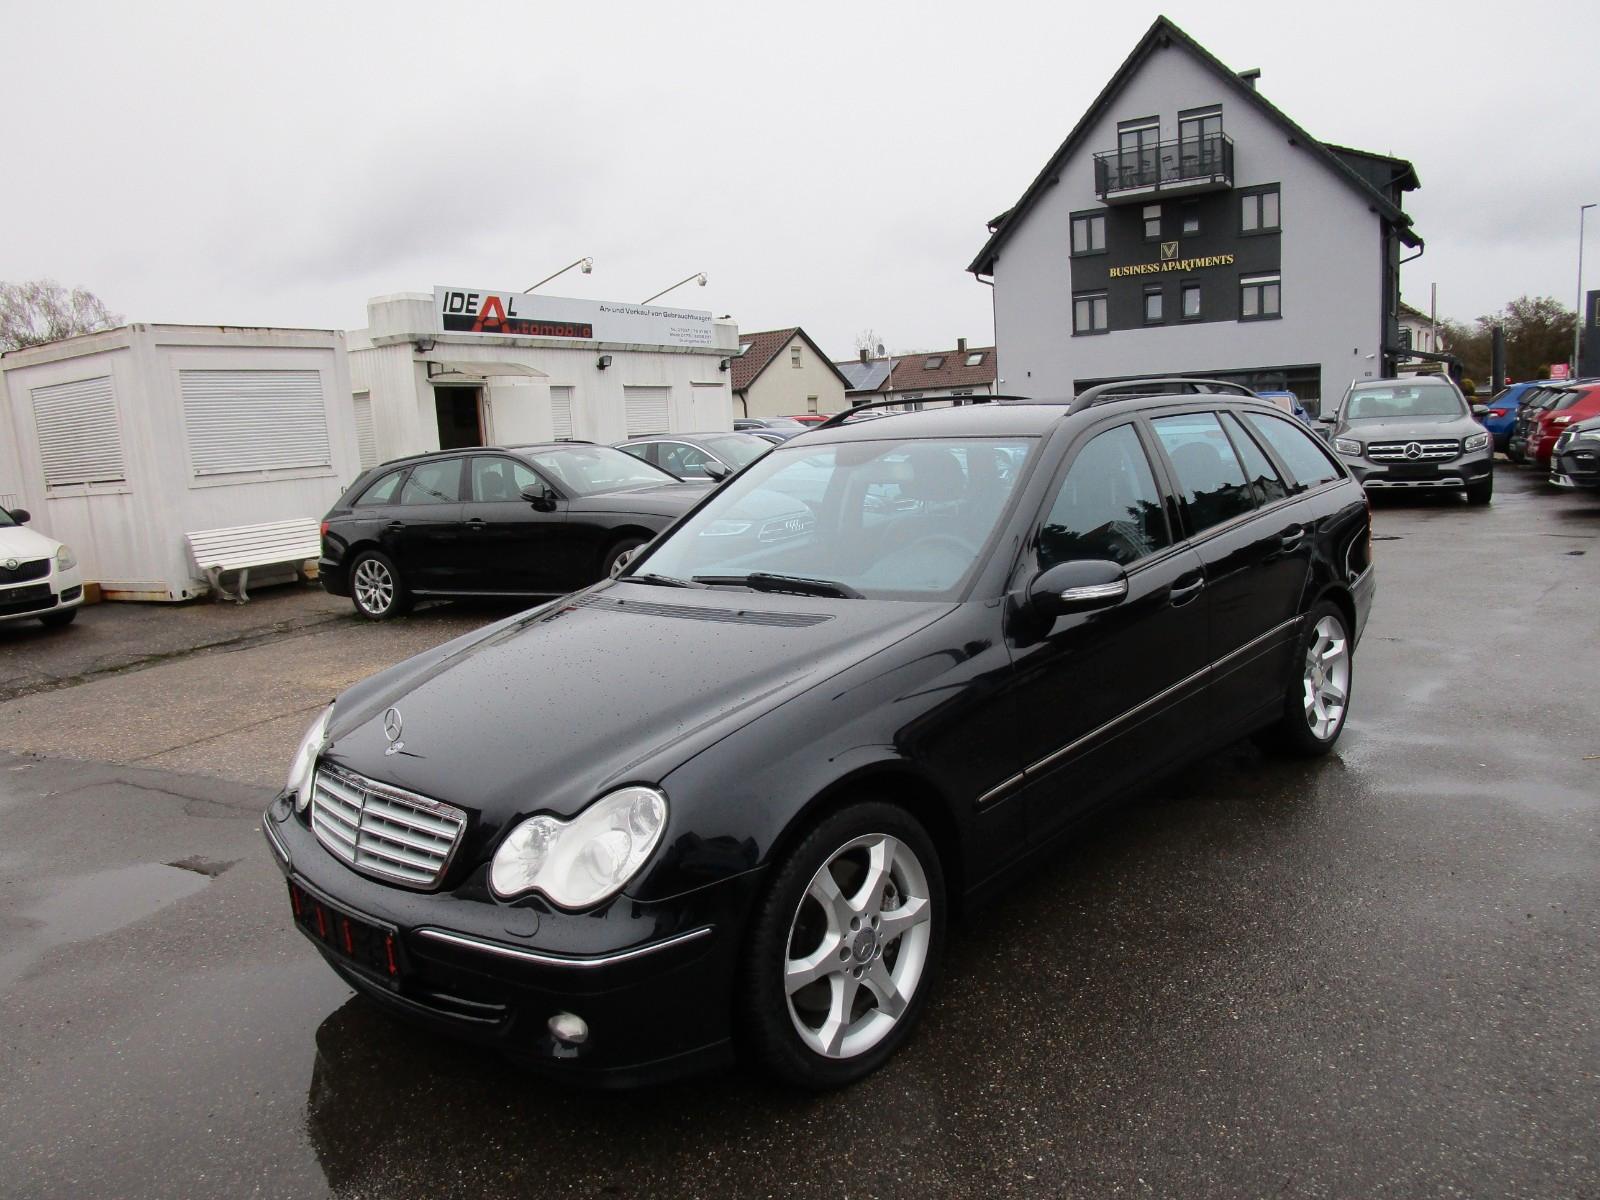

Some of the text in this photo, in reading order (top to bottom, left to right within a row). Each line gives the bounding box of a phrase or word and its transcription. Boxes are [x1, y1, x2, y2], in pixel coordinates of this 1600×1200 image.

[1109, 254, 1234, 278] BUSINESS APARTMENTS
[442, 291, 518, 334] IDEAL
[625, 308, 650, 316] Verkauf
